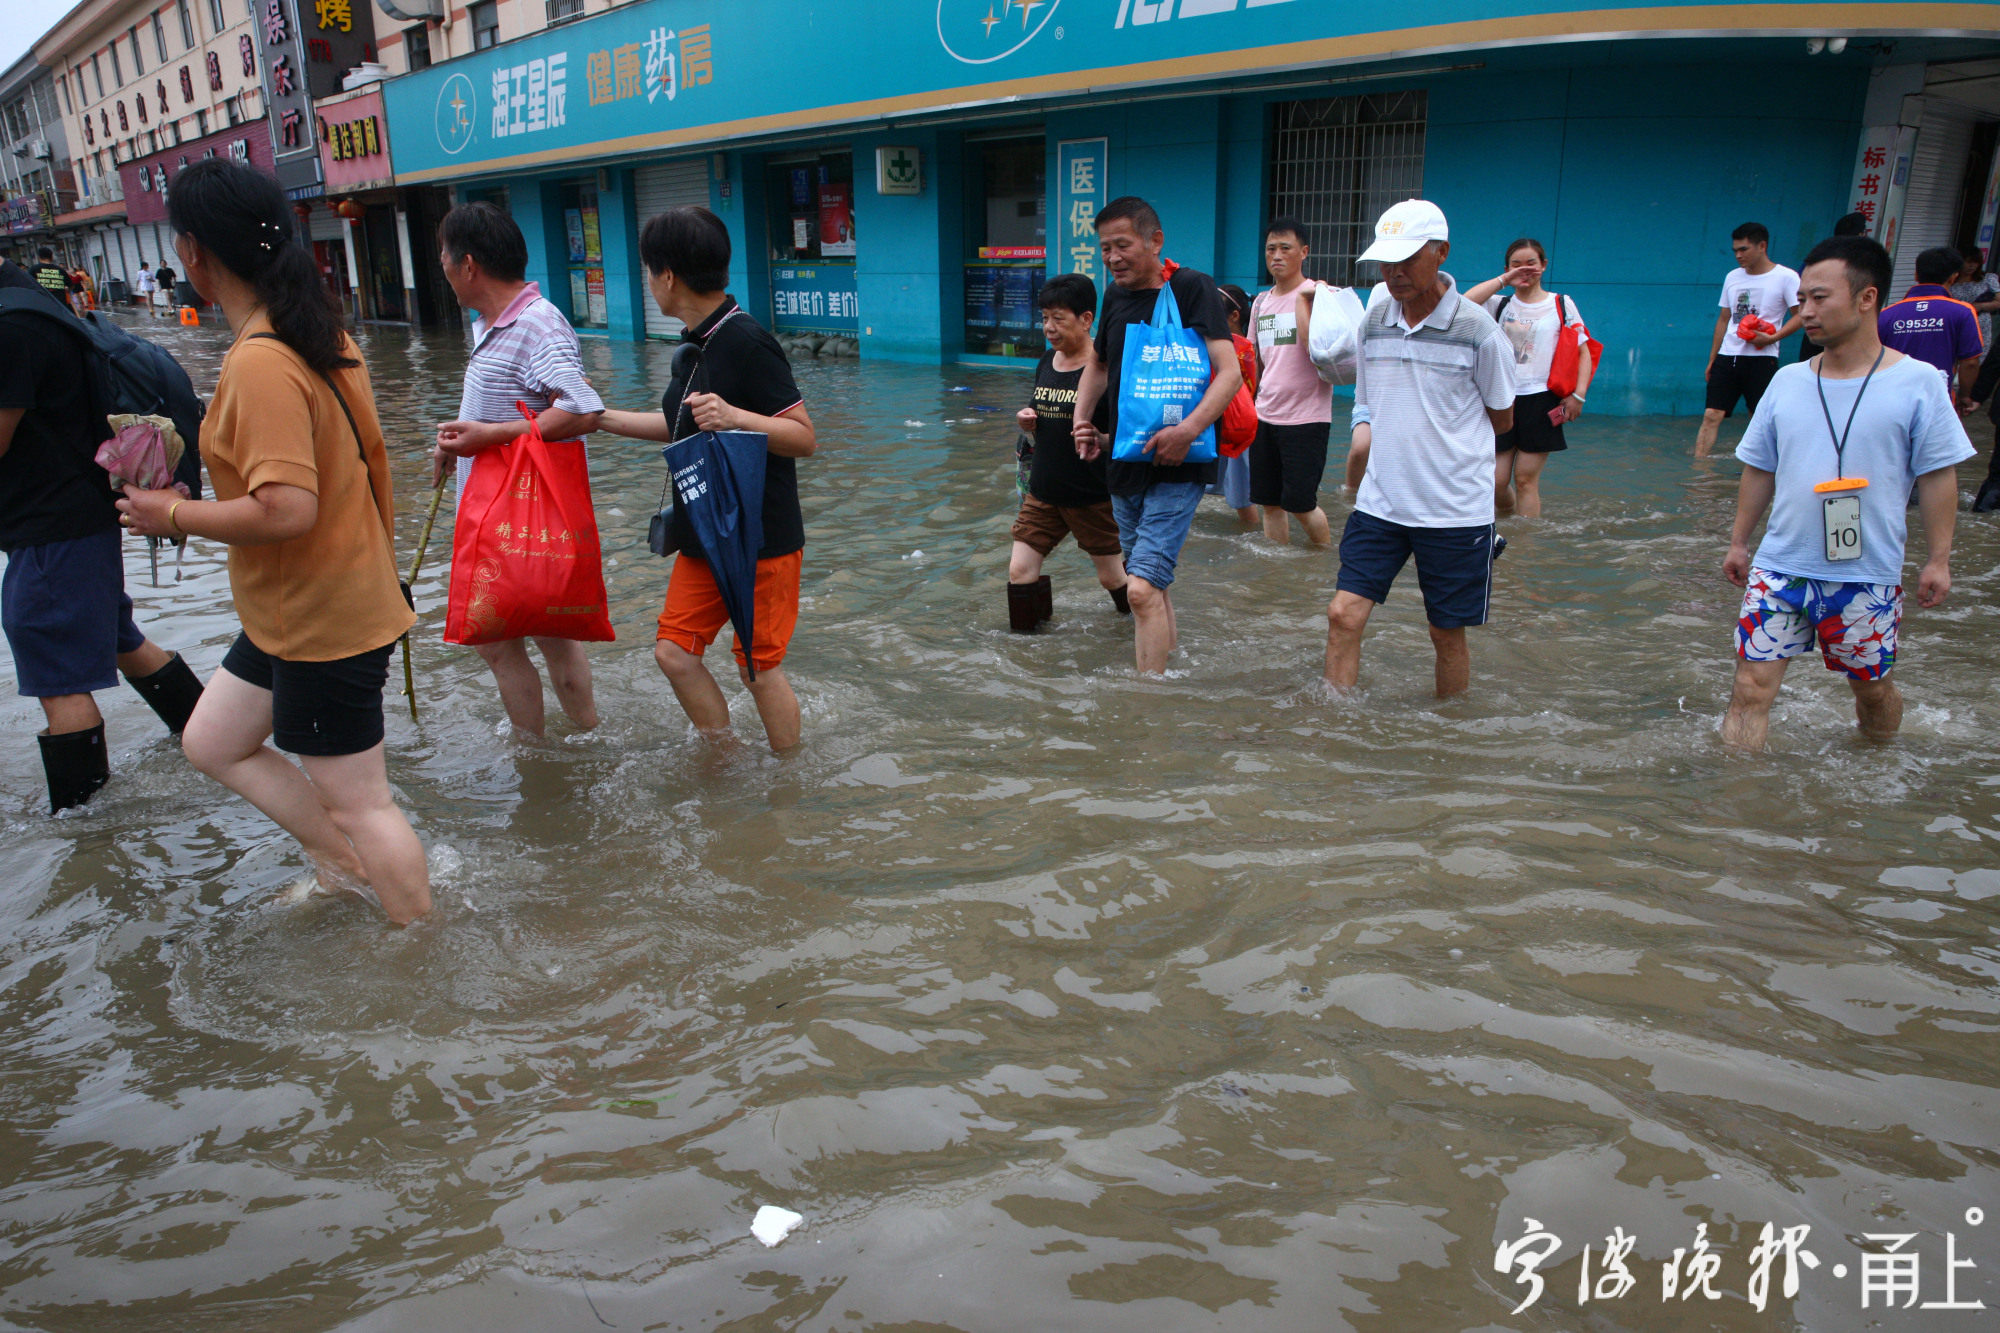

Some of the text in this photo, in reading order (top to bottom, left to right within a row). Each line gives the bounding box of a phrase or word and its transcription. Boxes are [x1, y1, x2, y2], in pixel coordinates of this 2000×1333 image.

[315, 0, 353, 32] 烤
[491, 24, 714, 139] 海王星辰 健康药房
[1069, 157, 1097, 280] 医保定
[1855, 146, 1887, 233] 标书装
[1906, 318, 1944, 329] 95324
[1830, 528, 1858, 548] 10
